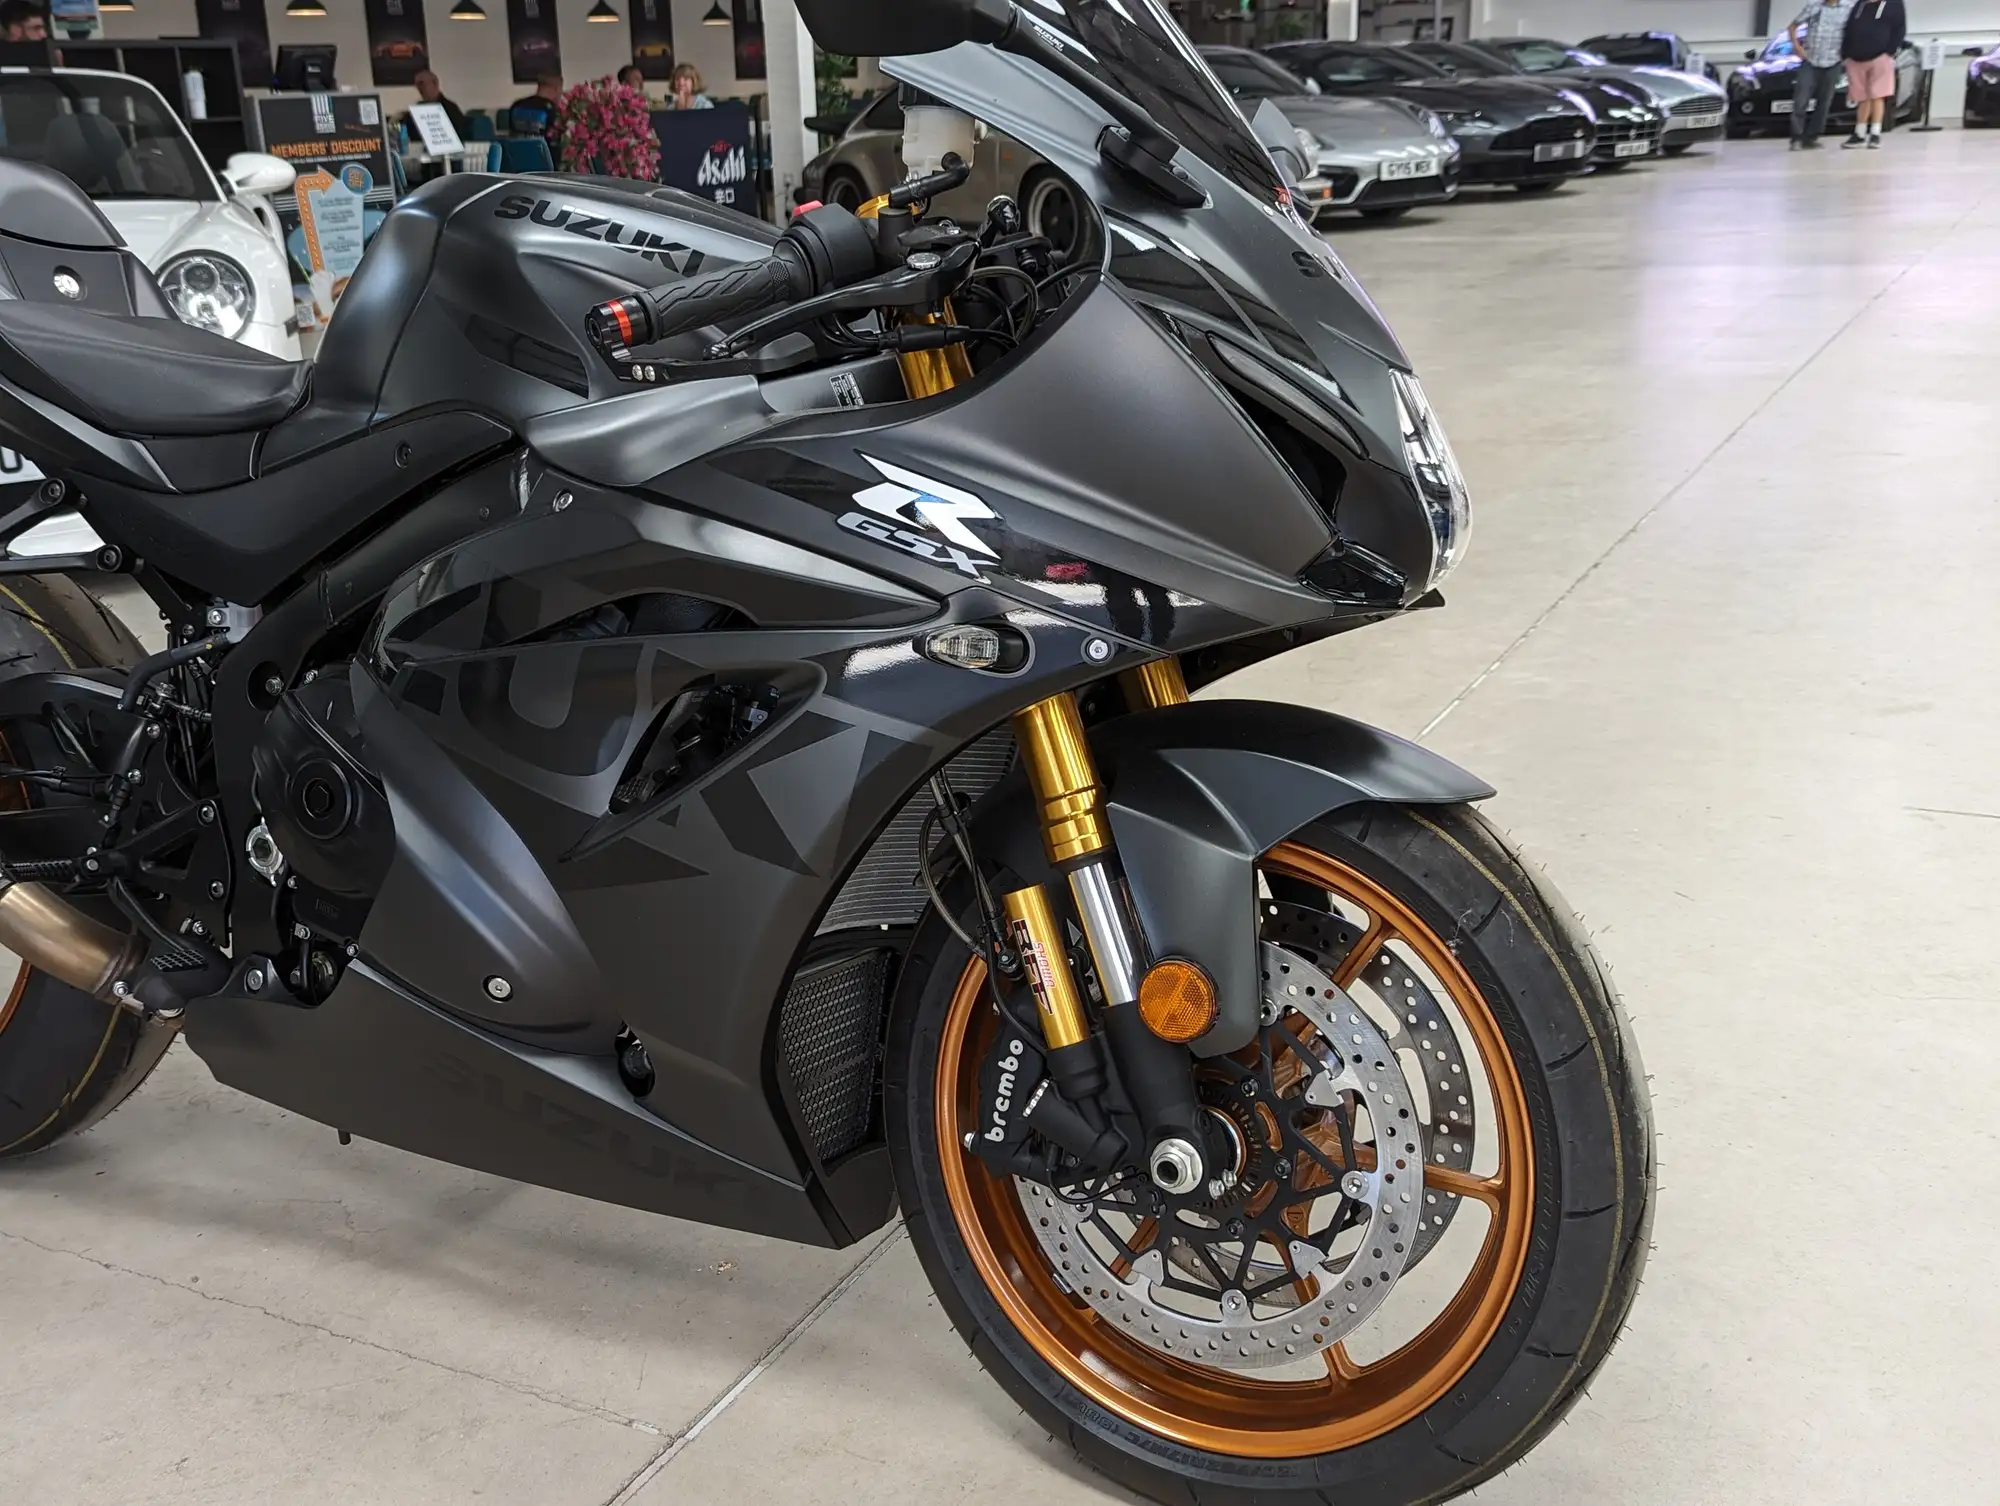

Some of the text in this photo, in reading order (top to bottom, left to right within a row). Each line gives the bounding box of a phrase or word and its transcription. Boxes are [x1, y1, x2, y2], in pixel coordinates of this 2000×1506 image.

[271, 138, 381, 157] MEMBERS' DISCOUNT
[697, 145, 746, 187] Asahi
[494, 195, 705, 278] SUZUKI
[852, 454, 1001, 559] R
[836, 512, 999, 577] GSX
[1032, 941, 1057, 989] SHOWA
[984, 1039, 1024, 1143] brembo
